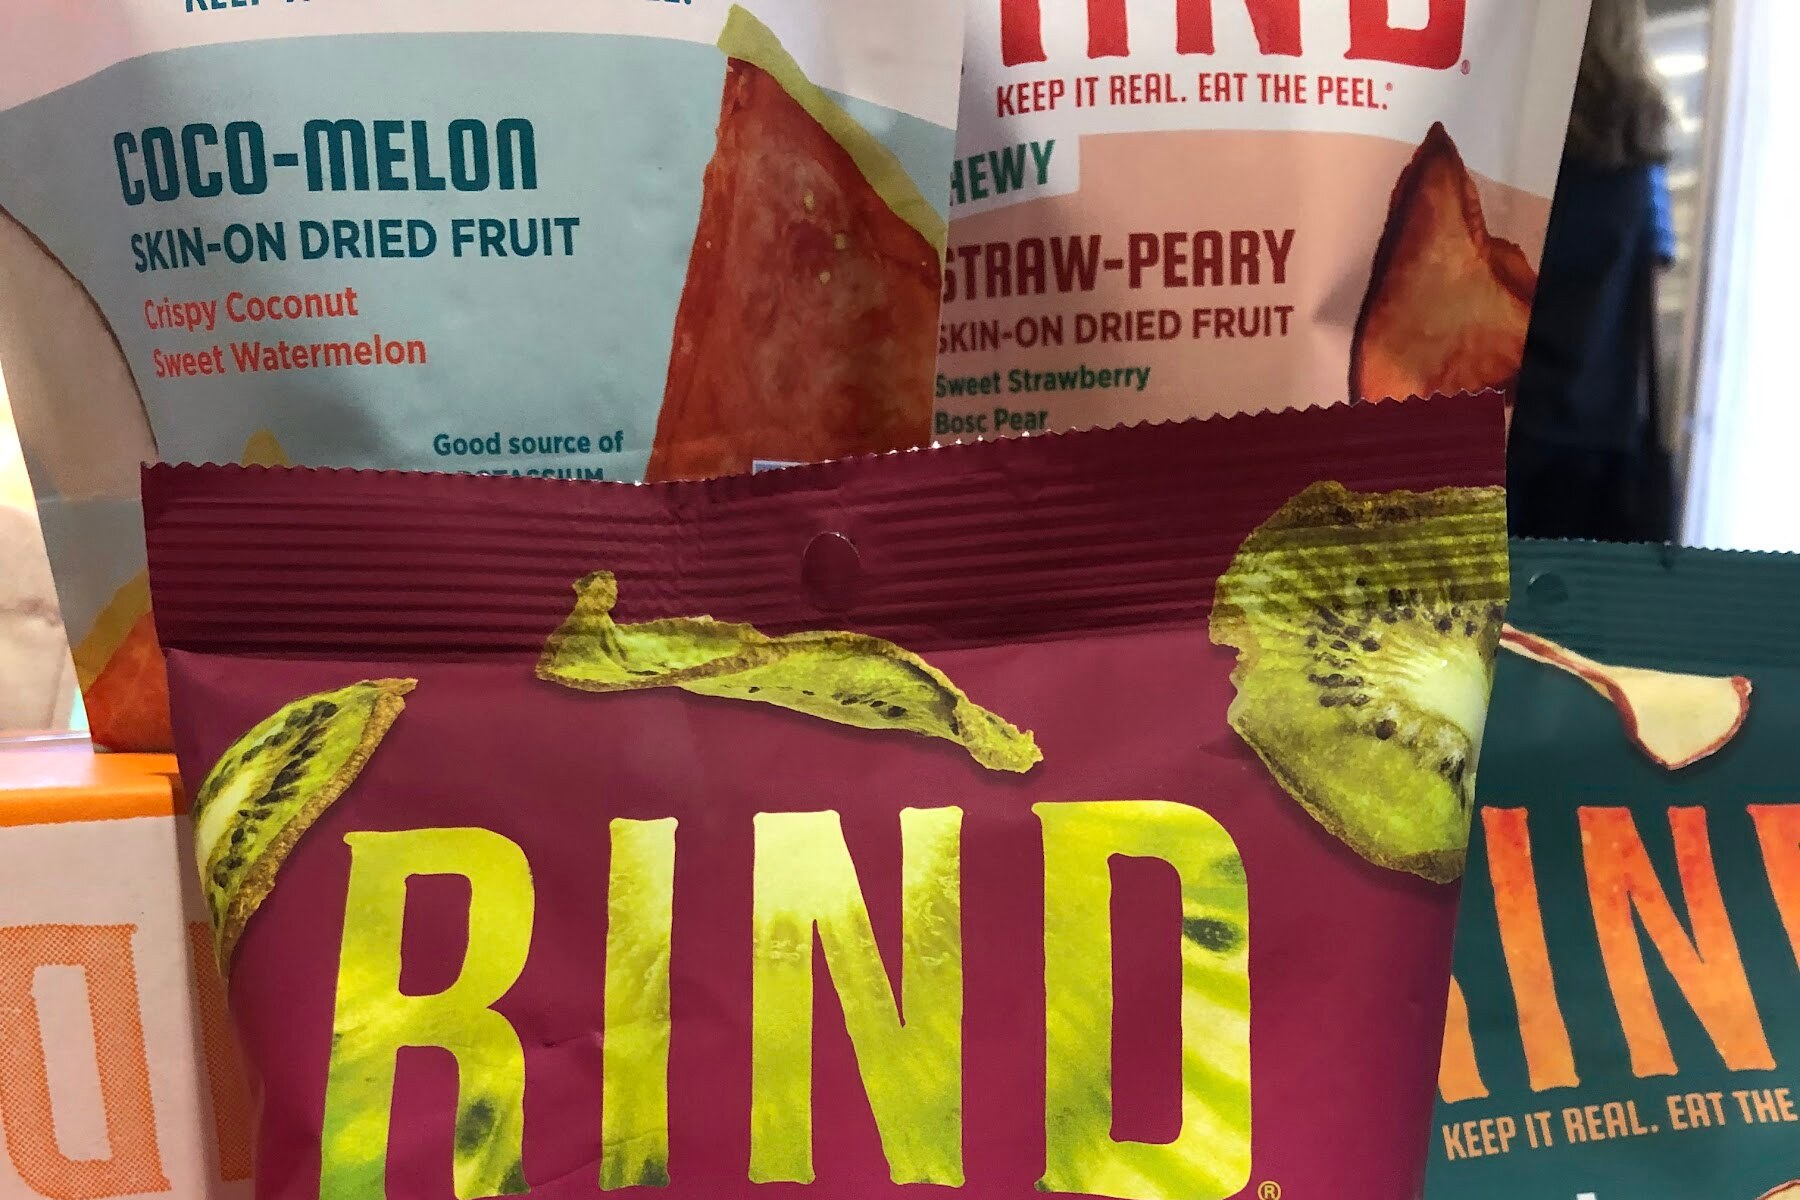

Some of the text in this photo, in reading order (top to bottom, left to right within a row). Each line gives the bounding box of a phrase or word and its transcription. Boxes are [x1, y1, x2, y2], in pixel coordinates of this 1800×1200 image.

[996, 79, 1065, 117] KEEP
[1075, 76, 1100, 108] IT
[1109, 73, 1188, 105] REAL.
[1198, 72, 1249, 102] EAT
[1256, 73, 1307, 104] THE
[113, 118, 538, 207] COCO-MELON
[949, 139, 1056, 207] HEWY
[131, 217, 580, 273] SKIN-ON DRIED FRUIT
[144, 286, 359, 333] Crispy Coconut
[1075, 308, 1183, 344] DRIED
[1192, 305, 1295, 339] FRUIT
[152, 333, 428, 380] Sweet Watermelon
[936, 364, 1152, 399] Sweet Strawberry
[433, 430, 625, 457] Good source of
[935, 407, 1049, 436] Bosc Pear
[1438, 804, 1800, 1103] IN
[1441, 1087, 1799, 1161] KEEP IT REAL. EAT THE
